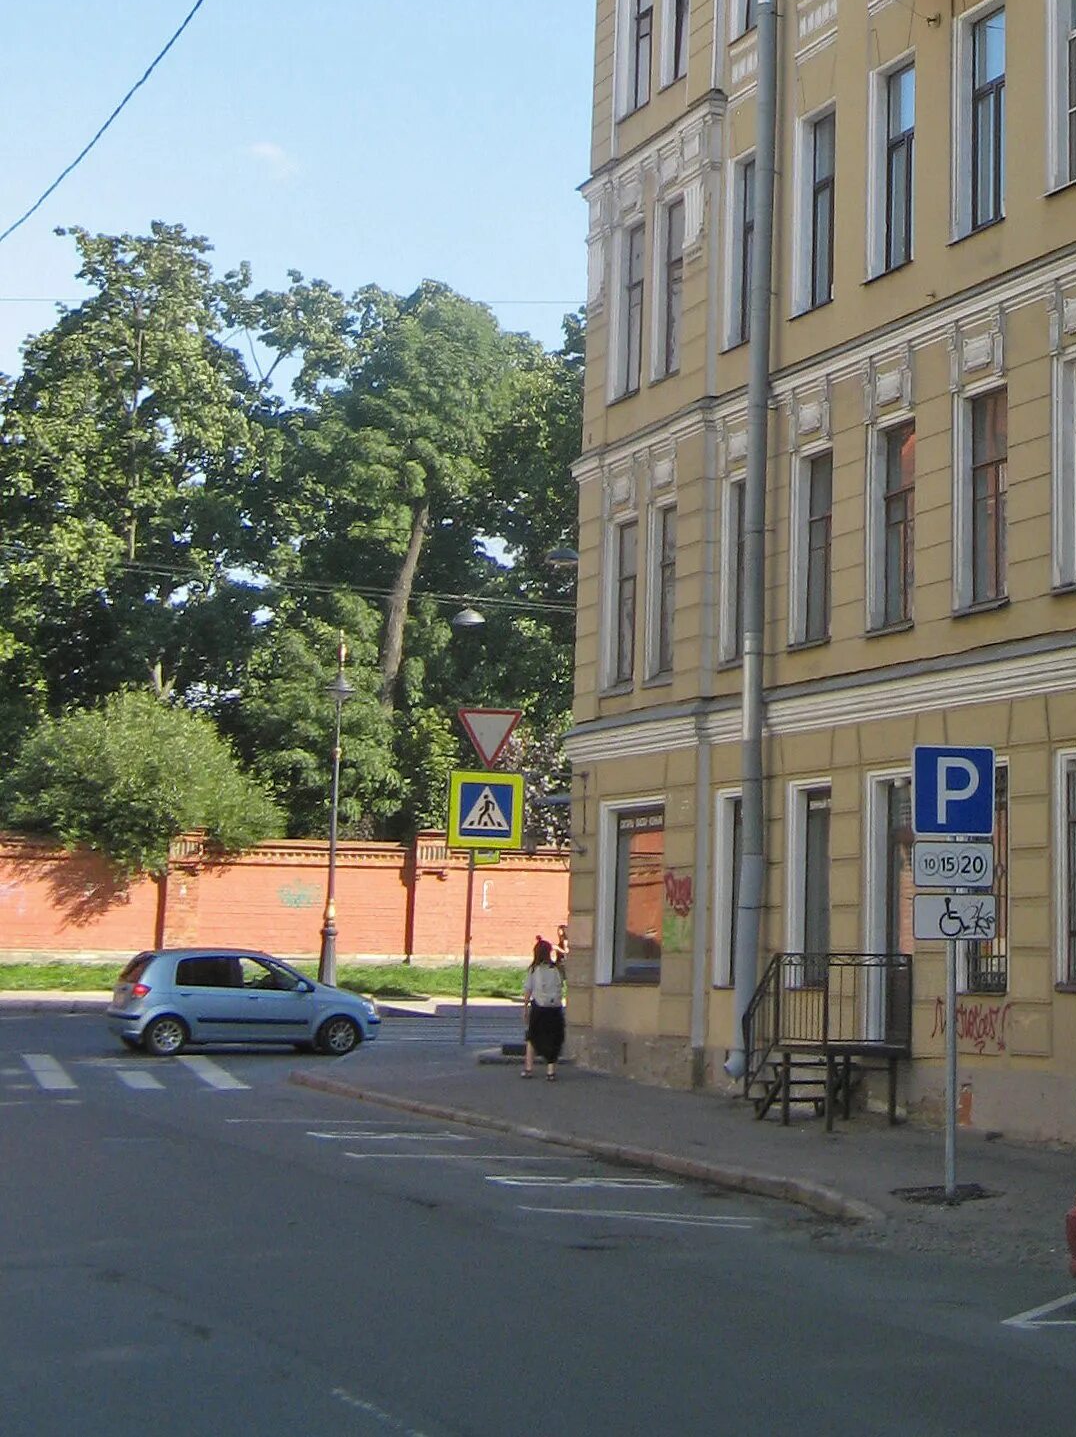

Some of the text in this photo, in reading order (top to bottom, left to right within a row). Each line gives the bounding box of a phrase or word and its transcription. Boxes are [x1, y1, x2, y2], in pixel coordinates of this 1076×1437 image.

[936, 756, 980, 825] P
[924, 856, 984, 874] 10 15 20
